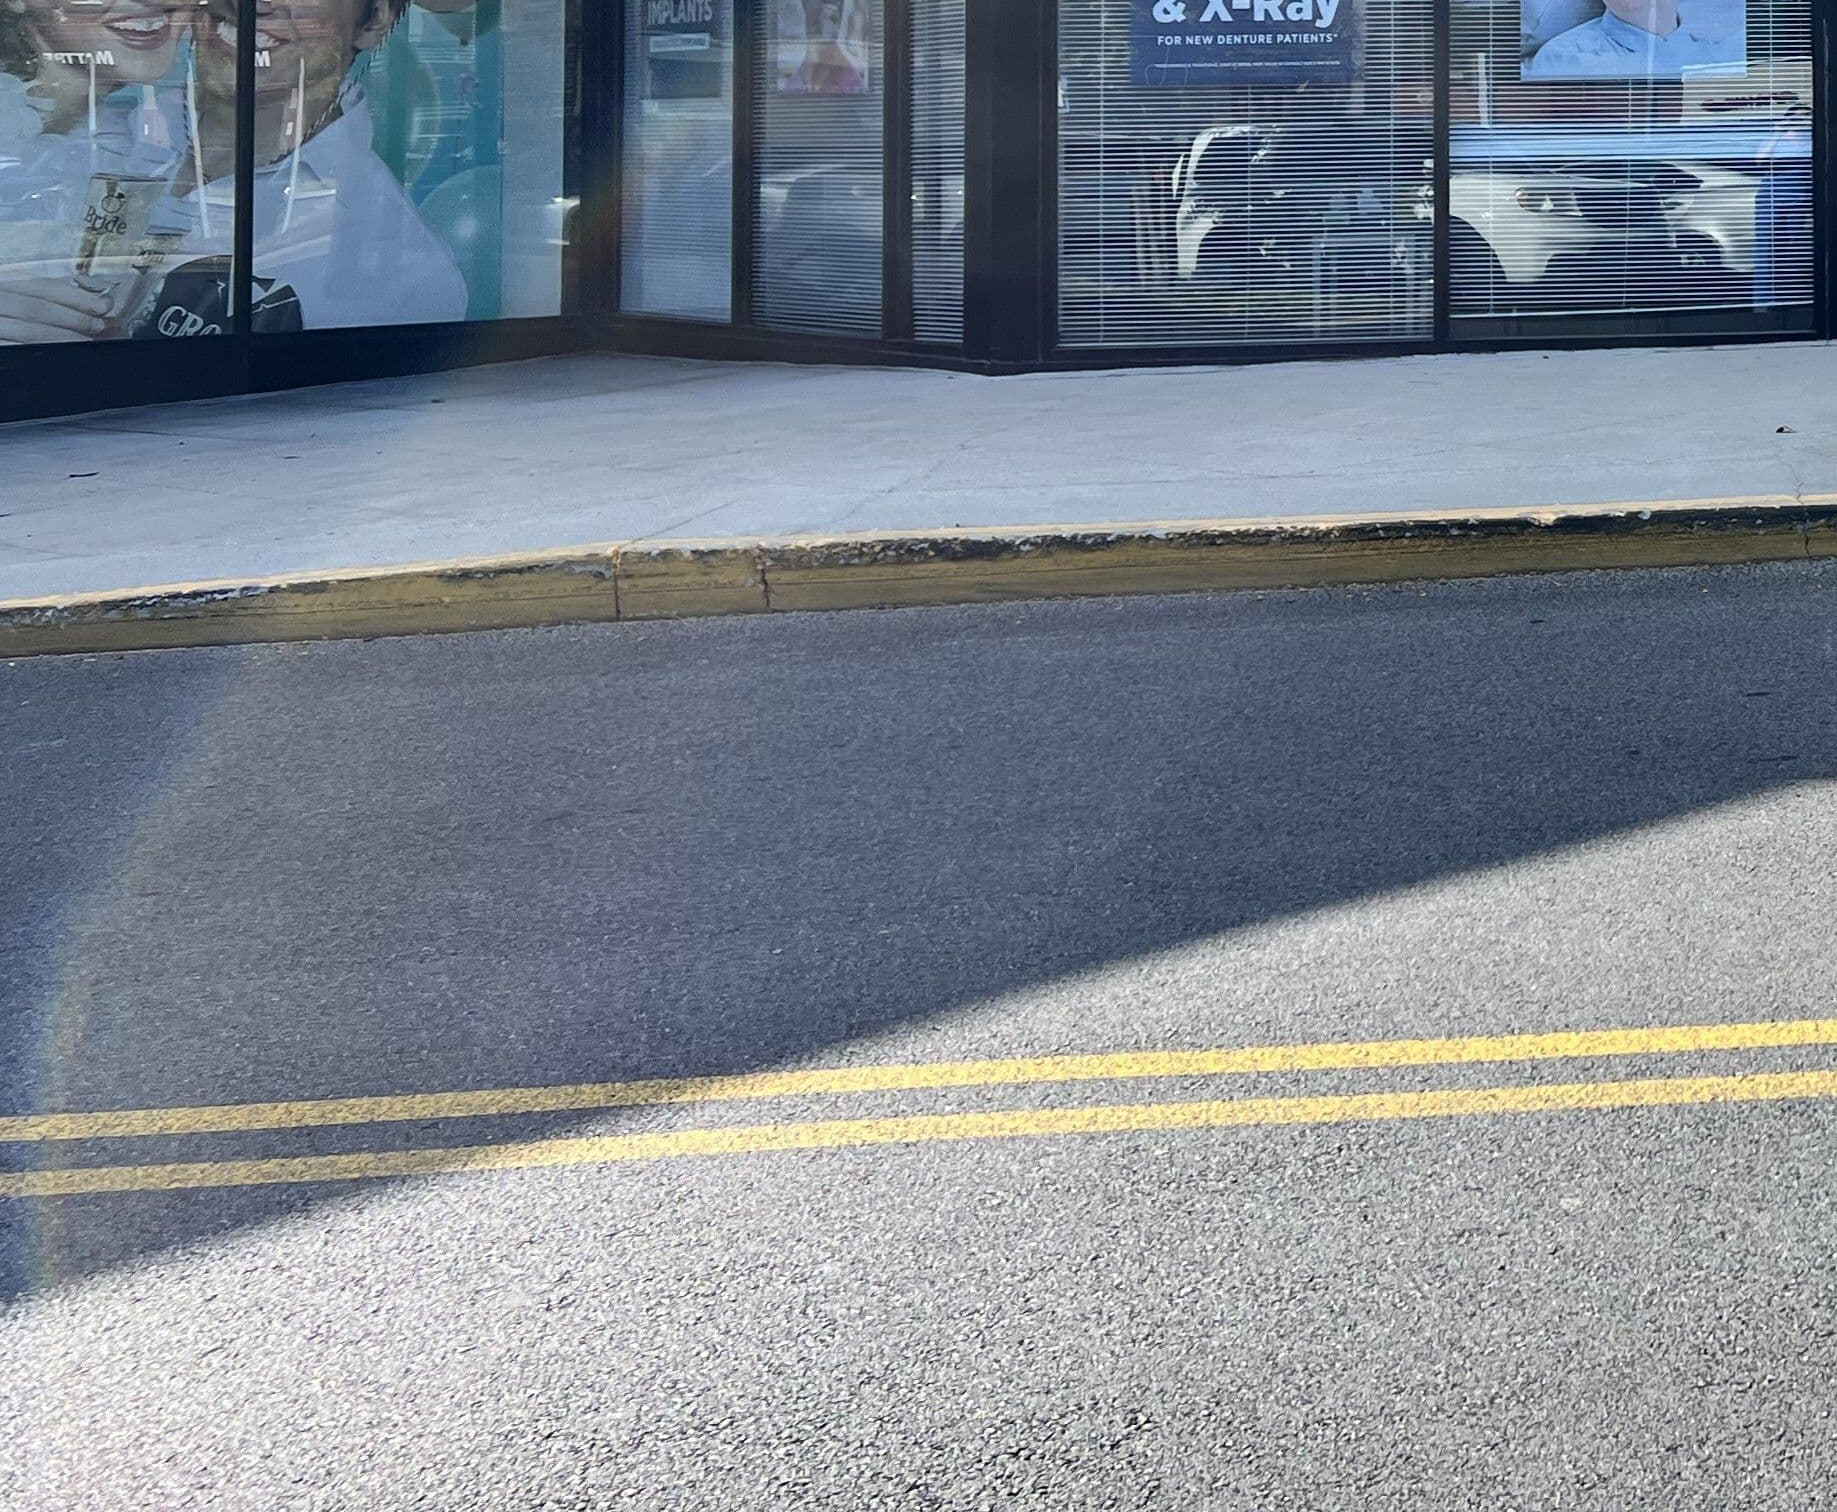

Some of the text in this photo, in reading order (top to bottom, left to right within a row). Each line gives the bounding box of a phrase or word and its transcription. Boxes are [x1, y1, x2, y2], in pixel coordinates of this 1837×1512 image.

[1157, 36, 1181, 45] FOR
[1185, 35, 1213, 45] NEW
[1217, 34, 1273, 45] DENTURE
[85, 205, 127, 235] Bride
